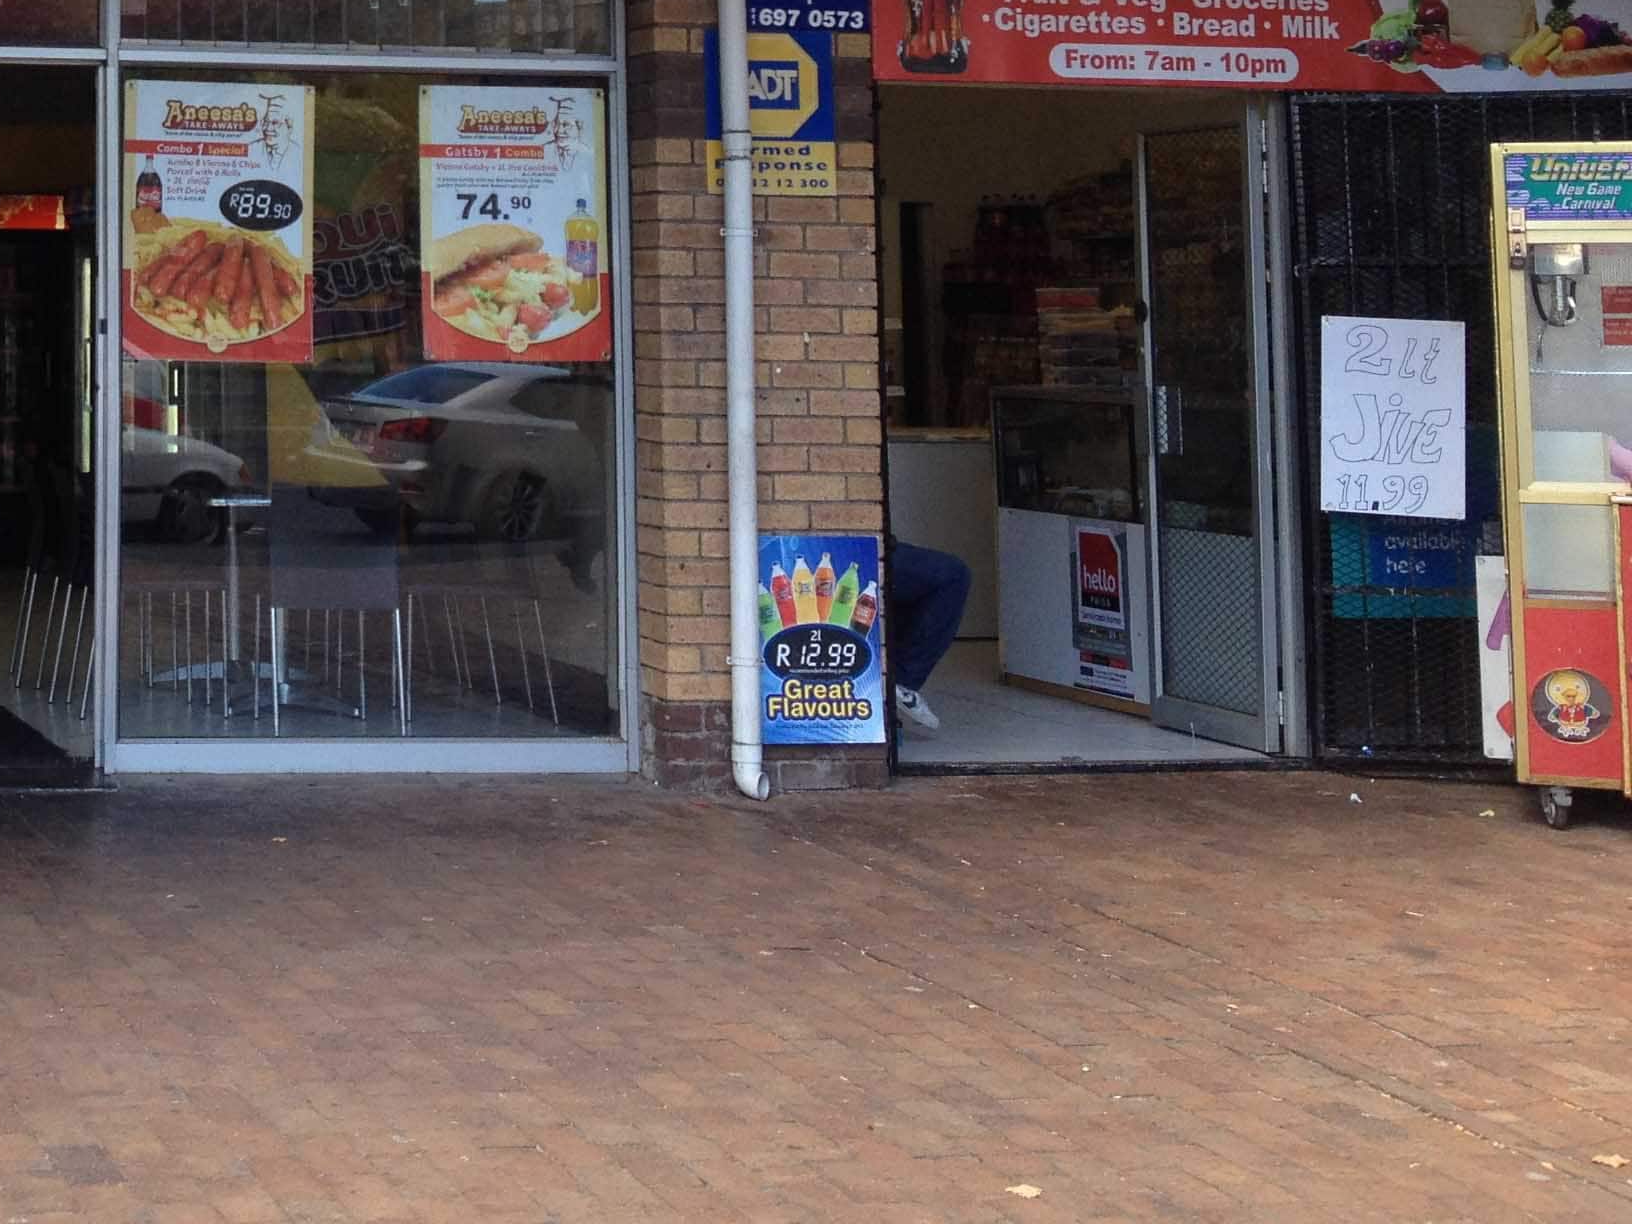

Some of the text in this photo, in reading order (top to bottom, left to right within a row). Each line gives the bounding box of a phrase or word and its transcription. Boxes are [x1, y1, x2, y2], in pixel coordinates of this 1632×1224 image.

[759, 8, 801, 26] 697
[808, 10, 865, 29] 0573
[994, 7, 1340, 40] Cigarettes Bread Milk
[1064, 49, 1135, 70] From:
[1144, 50, 1195, 72] 7am
[1220, 52, 1287, 76] 10pm
[748, 68, 797, 101] ADT
[156, 143, 193, 153] Combo
[751, 145, 811, 156] rmed
[800, 178, 829, 188] 300
[1556, 183, 1622, 196] New Game
[1561, 197, 1616, 209] Carnival
[1083, 564, 1117, 593] hello
[784, 679, 852, 700] Great
[768, 698, 870, 718] Flavours
